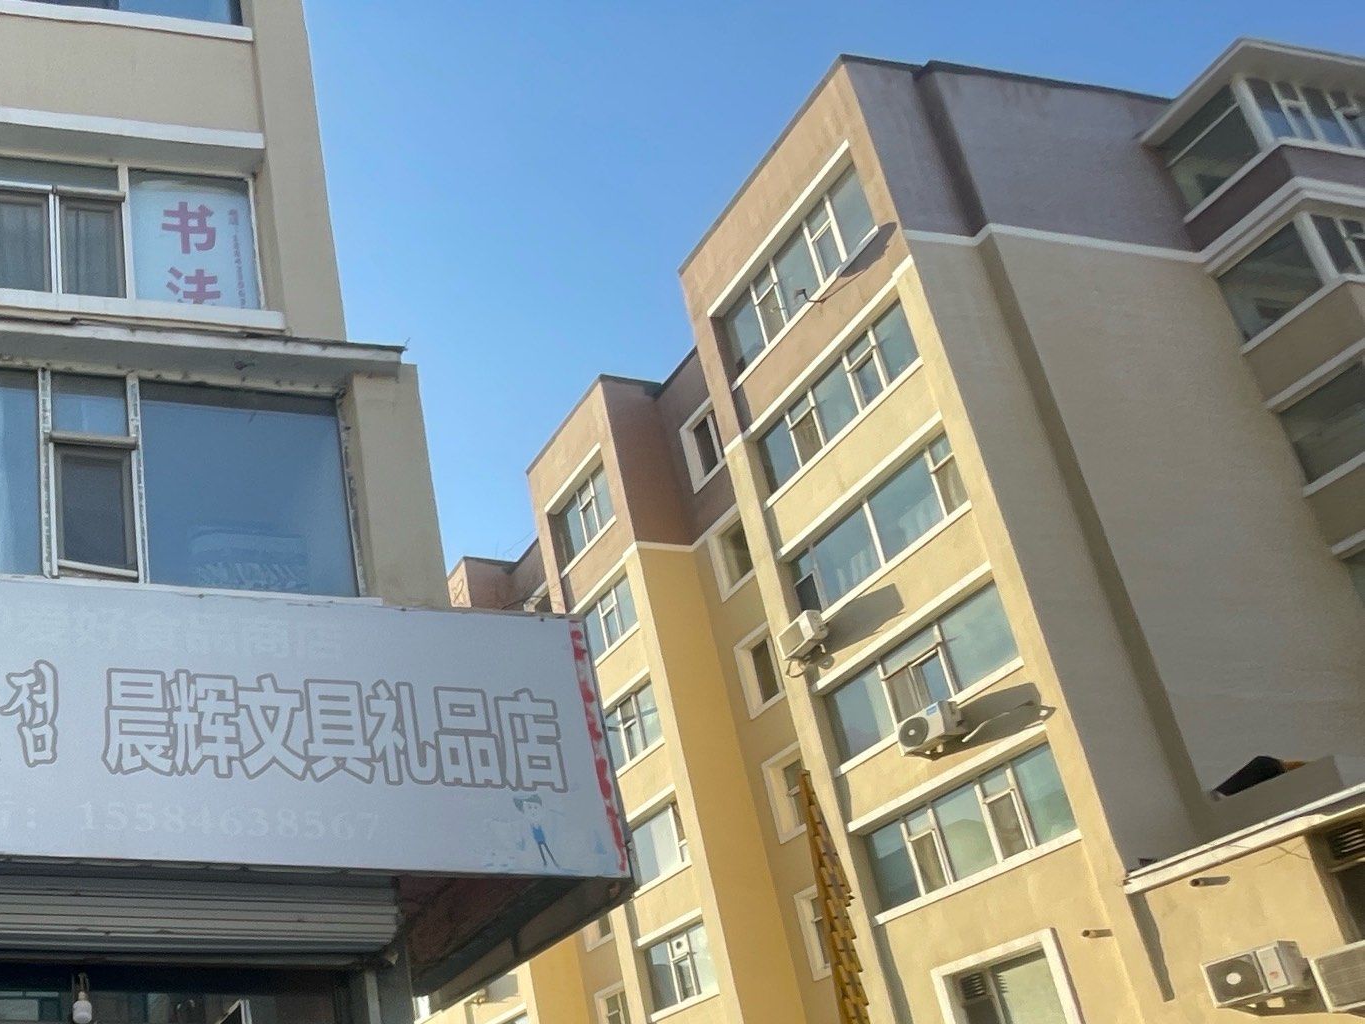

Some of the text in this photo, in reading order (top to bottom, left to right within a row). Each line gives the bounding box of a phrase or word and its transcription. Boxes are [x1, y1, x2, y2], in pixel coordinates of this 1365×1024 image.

[102, 667, 569, 793] 晨辉文具礼品店
